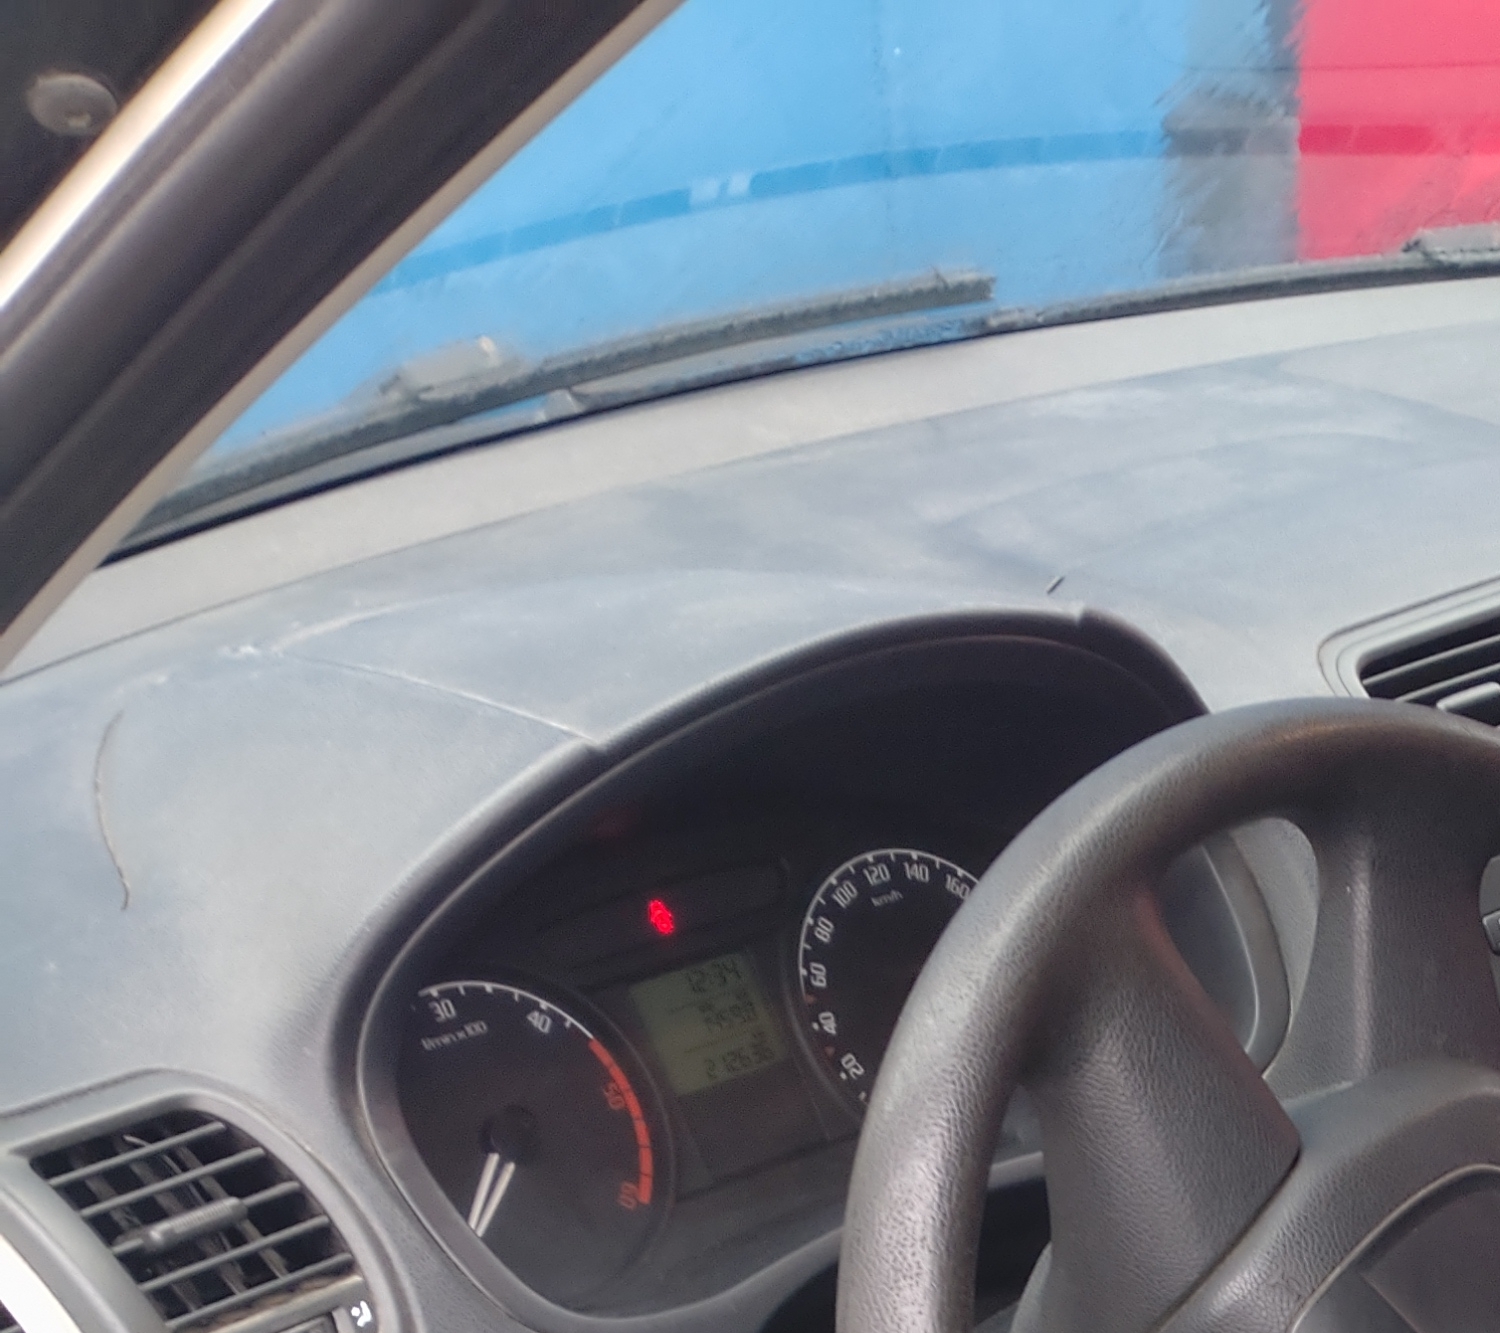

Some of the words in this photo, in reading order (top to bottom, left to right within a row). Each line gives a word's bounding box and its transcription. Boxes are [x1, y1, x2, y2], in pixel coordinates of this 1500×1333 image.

[862, 863, 891, 887] 120
[903, 861, 930, 884] 140
[831, 880, 859, 909] 100
[870, 889, 904, 907] km/h
[813, 916, 836, 944] 80
[809, 962, 828, 989] 60
[428, 998, 457, 1023] 30
[526, 1009, 553, 1035] 40
[818, 1011, 838, 1036] 40
[840, 1052, 866, 1081] 20
[603, 1082, 627, 1111] 50
